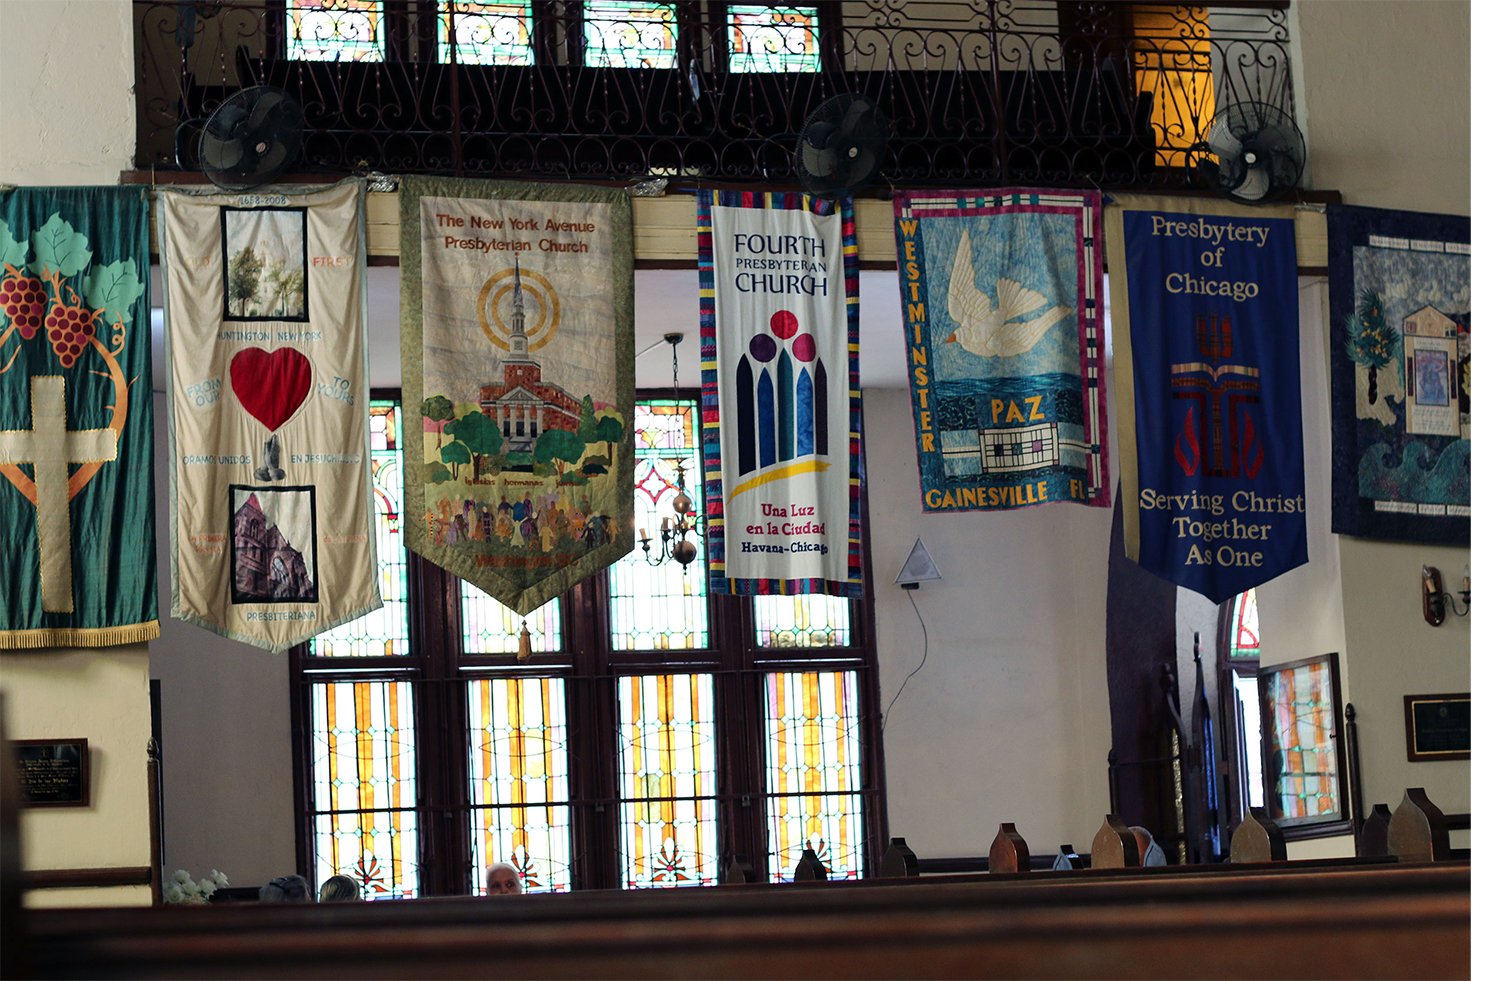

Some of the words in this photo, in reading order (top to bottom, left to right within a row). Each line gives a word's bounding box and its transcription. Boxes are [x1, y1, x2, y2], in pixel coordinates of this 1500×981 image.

[240, 196, 287, 205] 1658-2008
[436, 214, 465, 227] The
[471, 216, 503, 229] New
[508, 217, 539, 231] York
[545, 219, 595, 233] Avenue
[1151, 215, 1270, 248] Presbytery
[445, 236, 532, 254] Presbyterian
[538, 239, 589, 253] Church
[734, 234, 826, 257] FOURTH
[184, 256, 210, 268] OLD
[313, 256, 352, 268] FIRST
[1200, 246, 1226, 267] of
[735, 272, 827, 296] CHURCH
[1165, 272, 1260, 302] Chicago
[217, 331, 270, 341] HUNTINGTON
[277, 331, 298, 341] NEW
[299, 331, 322, 341] YORK
[899, 219, 936, 453] WESTMINSTER
[186, 378, 222, 399] FROM
[333, 376, 350, 390] TO
[195, 390, 220, 407] OUR
[317, 383, 354, 406] YOURS
[991, 395, 1045, 423] PAZ
[218, 455, 251, 465] UNIDOS
[291, 454, 303, 463] EN
[464, 477, 496, 487] iglesias
[504, 478, 544, 486] hermanas
[925, 481, 1048, 508] GAINESVILLE
[1070, 478, 1086, 500] FL
[1139, 488, 1225, 516] Serving
[1231, 490, 1306, 514] Christ
[761, 503, 787, 518] Una
[790, 503, 815, 517] Luz
[746, 525, 764, 535] en
[767, 521, 779, 535] la
[781, 521, 826, 536] Ciudad
[1172, 516, 1272, 542] Together
[741, 541, 829, 556] Havana-Chicago
[1184, 543, 1213, 566] As
[1216, 545, 1264, 567] One
[246, 610, 316, 622] PRESBITERIANA
